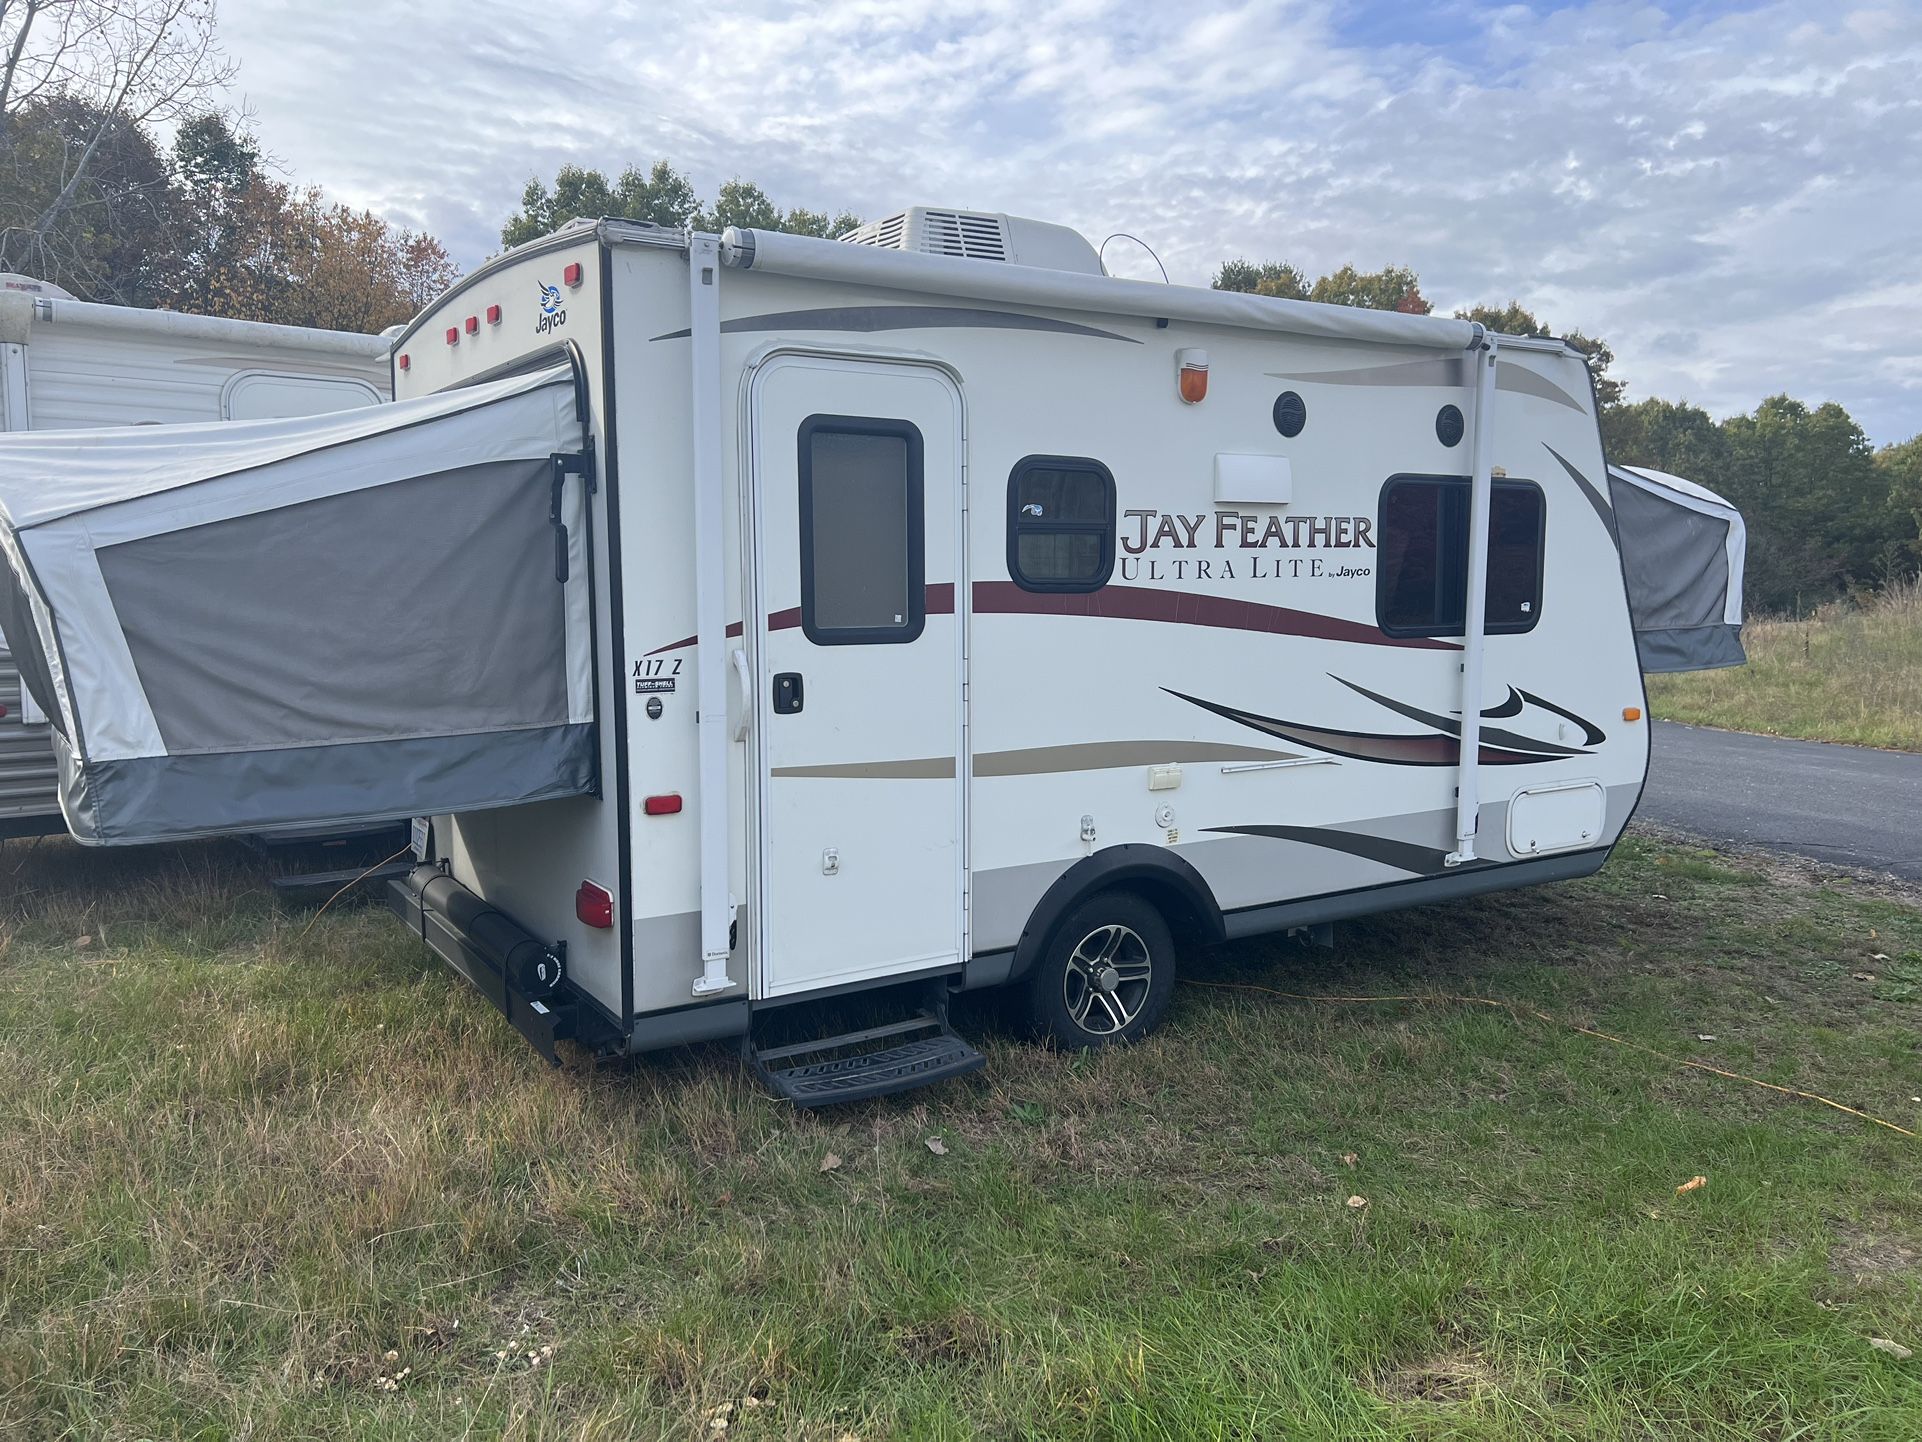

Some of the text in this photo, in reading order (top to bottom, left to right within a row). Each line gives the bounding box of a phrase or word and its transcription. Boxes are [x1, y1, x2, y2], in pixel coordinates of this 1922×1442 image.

[536, 309, 566, 334] Jayco
[1120, 510, 1376, 554] JAY FEATHER
[1120, 557, 1371, 580] ULTRA LITE by Jayco
[632, 659, 682, 676] X17 Z
